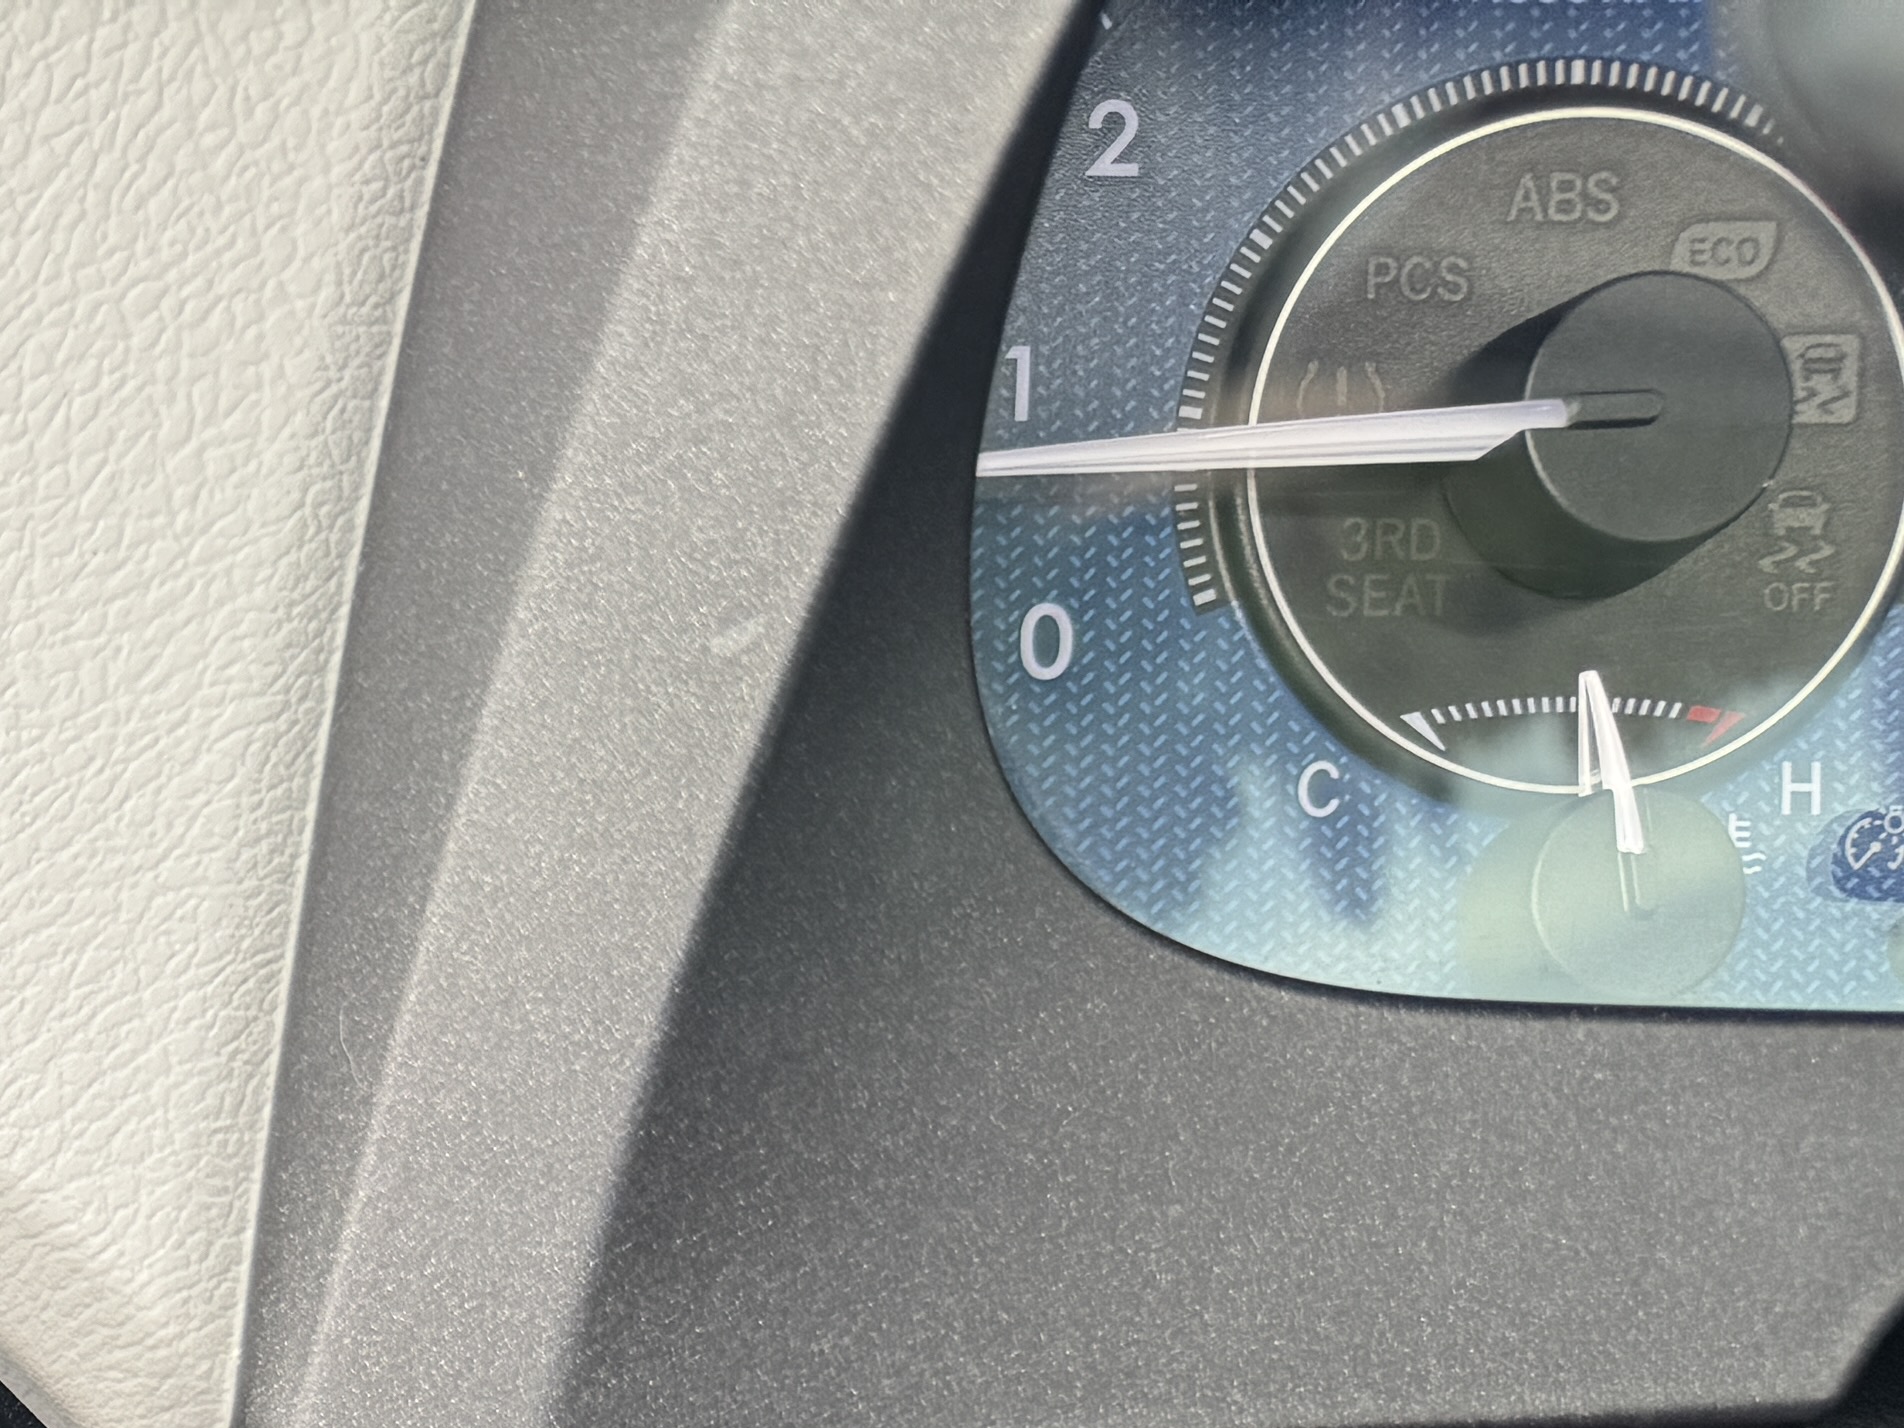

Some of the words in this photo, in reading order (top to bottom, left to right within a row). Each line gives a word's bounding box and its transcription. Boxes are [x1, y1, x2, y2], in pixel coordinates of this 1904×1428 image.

[1084, 98, 1140, 177] 2
[1506, 170, 1621, 223] ABS
[1367, 256, 1471, 301] PCS
[1688, 237, 1761, 267] ECO
[1005, 345, 1034, 422] 1
[1340, 517, 1442, 562] 3RD
[1326, 575, 1451, 619] SEAT
[1763, 583, 1835, 611] OFF
[1020, 603, 1074, 681] 0
[1298, 760, 1340, 818] C
[1781, 761, 1821, 815] H
